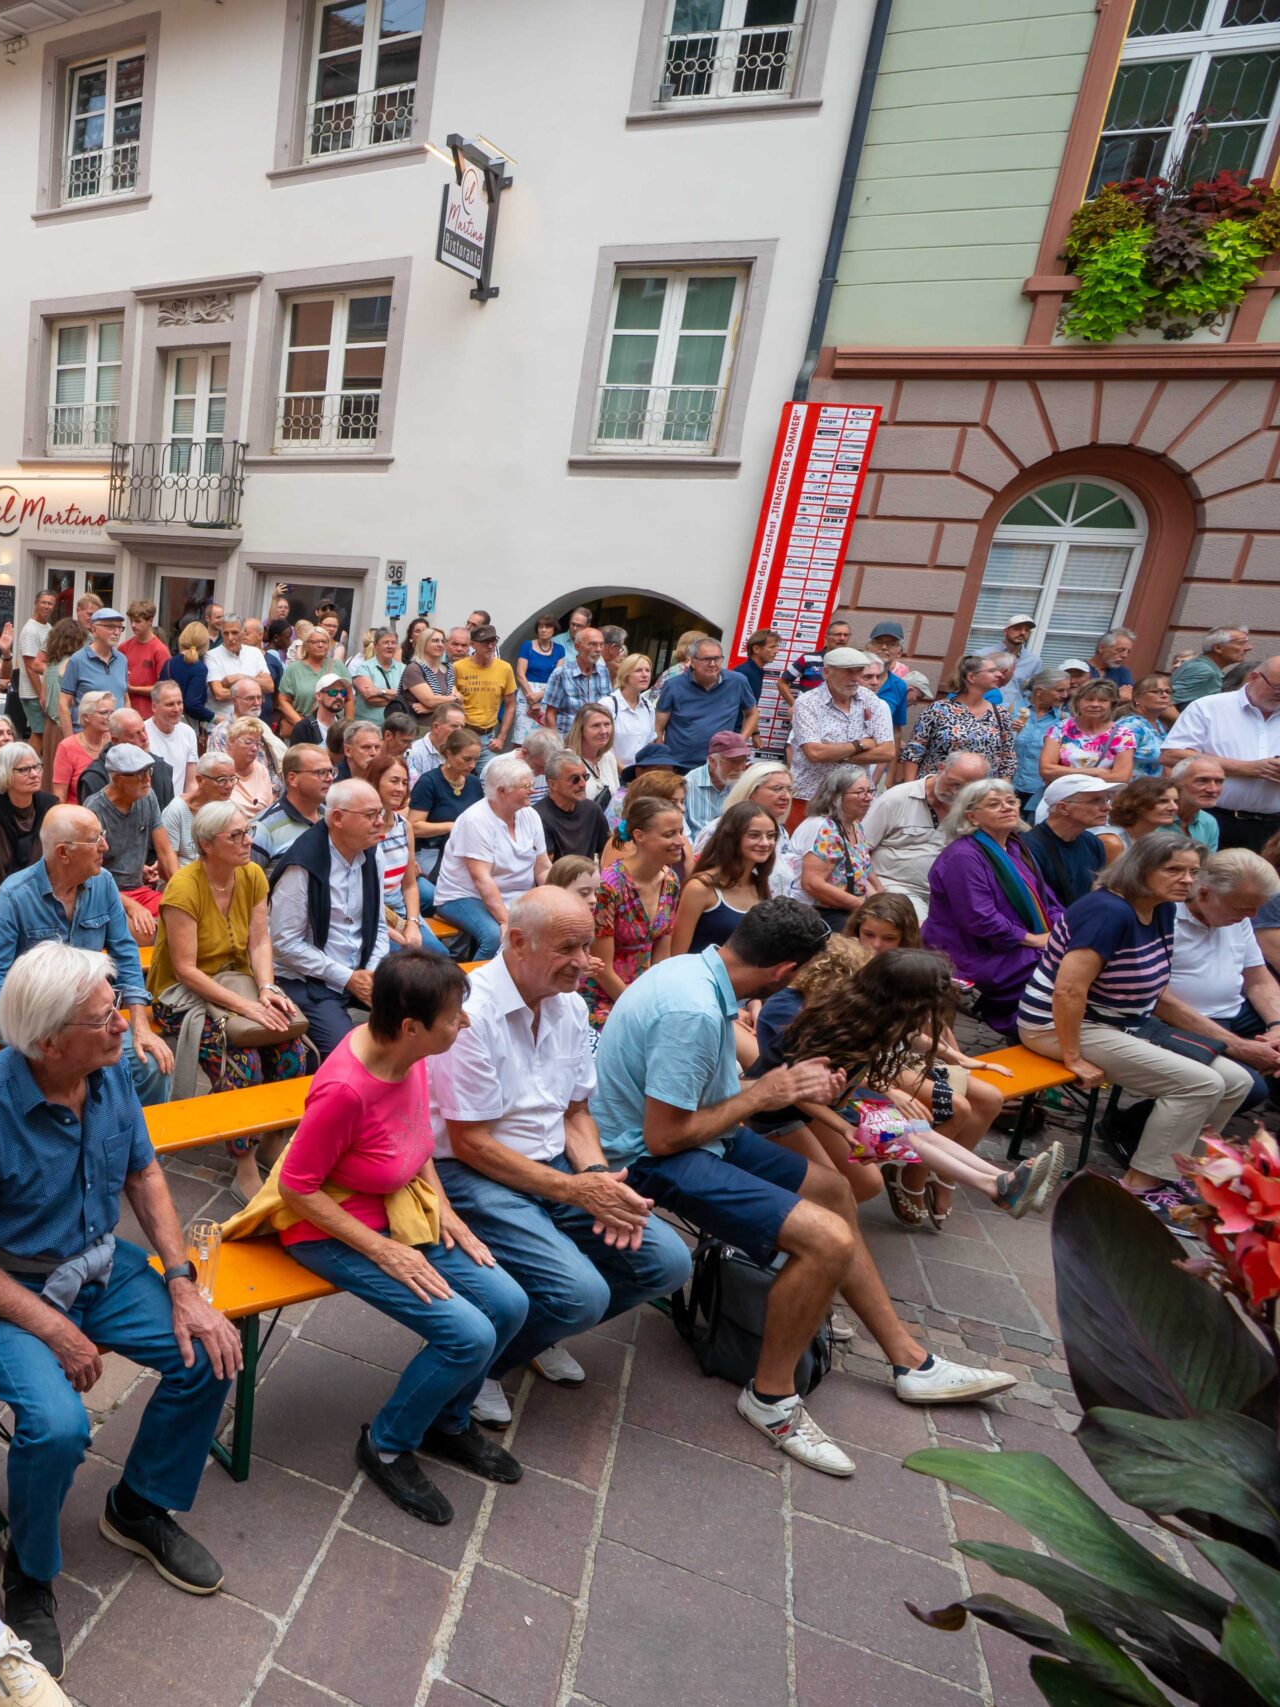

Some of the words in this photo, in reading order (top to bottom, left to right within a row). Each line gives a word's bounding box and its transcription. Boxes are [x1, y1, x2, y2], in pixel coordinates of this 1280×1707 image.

[464, 181, 476, 205] il
[447, 202, 484, 242] Martino
[444, 233, 481, 267] Ristorante
[19, 496, 109, 531] Martino
[43, 527, 76, 535] Ristorante
[78, 527, 89, 535] del
[90, 528, 102, 536] Sud
[762, 521, 777, 558] Jazzfest
[388, 565, 403, 580] 36
[758, 560, 768, 577] das
[746, 579, 764, 636] unterstützen
